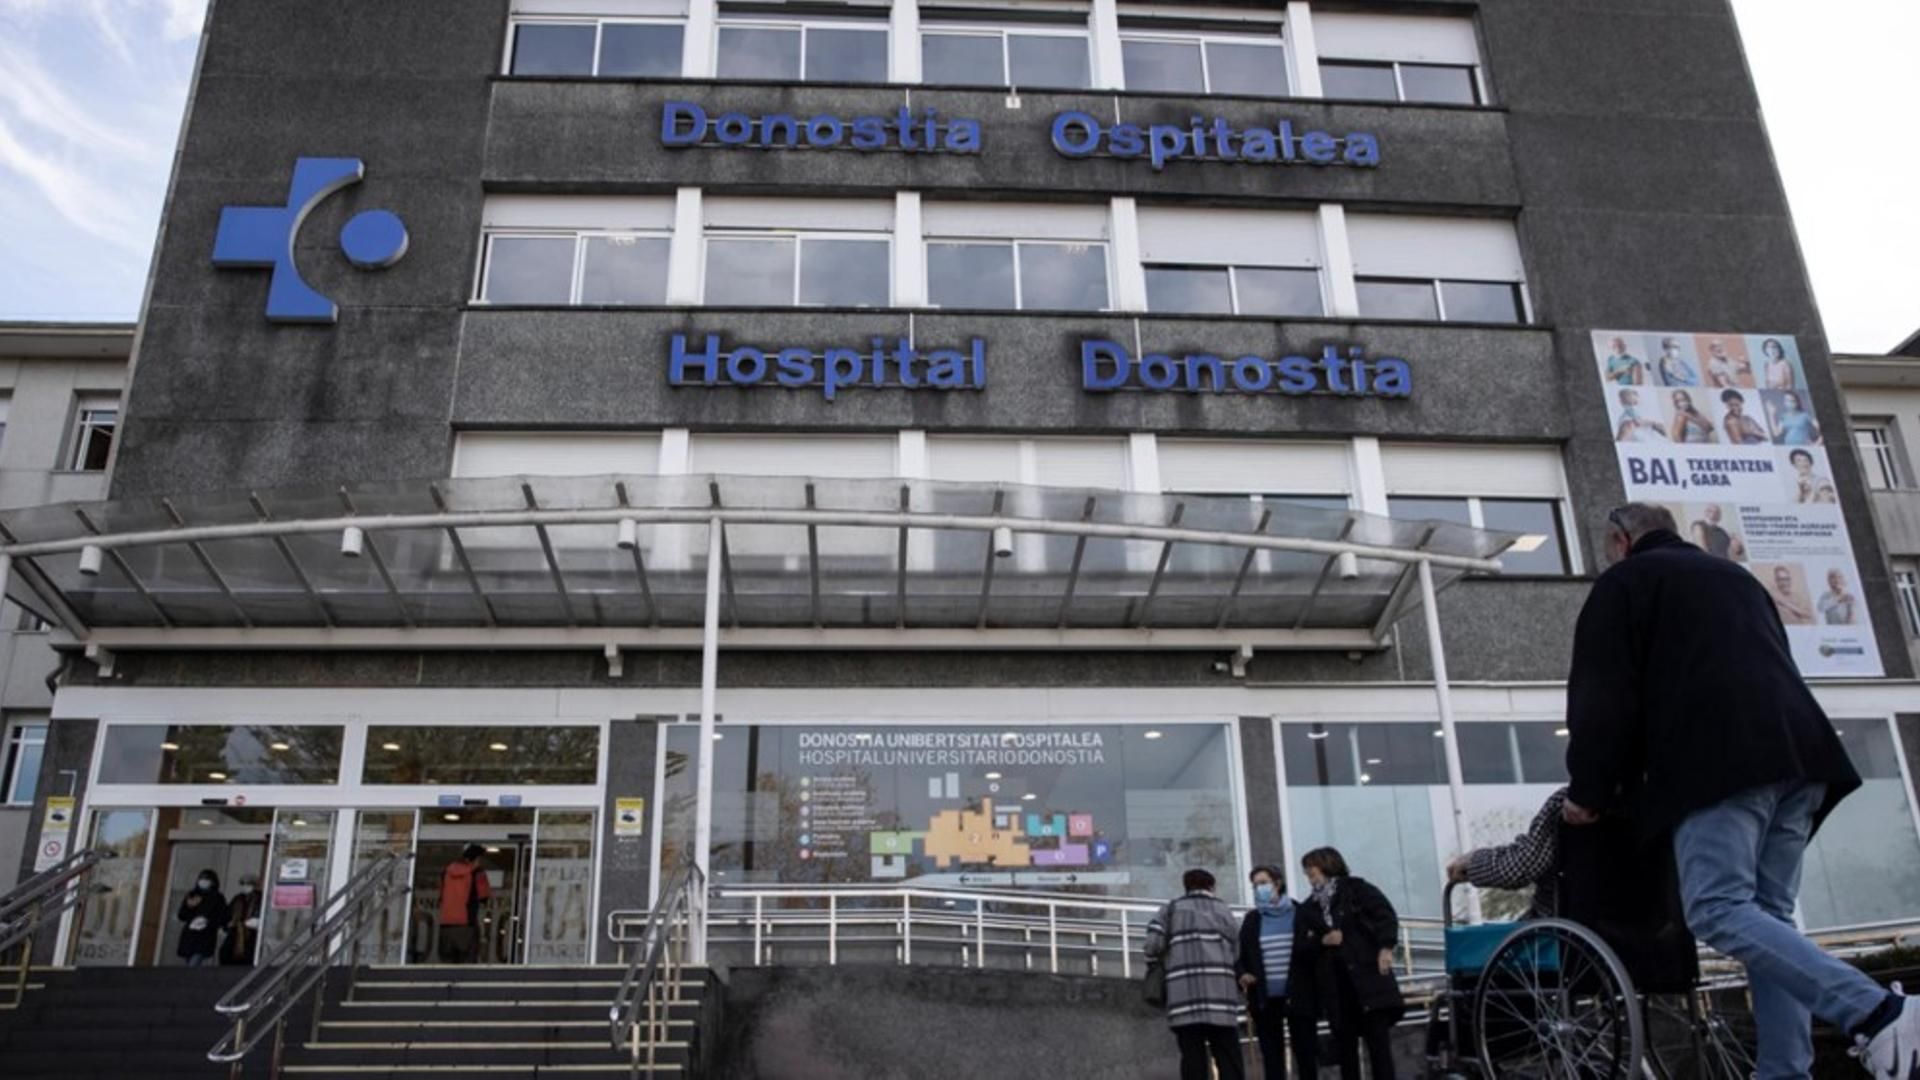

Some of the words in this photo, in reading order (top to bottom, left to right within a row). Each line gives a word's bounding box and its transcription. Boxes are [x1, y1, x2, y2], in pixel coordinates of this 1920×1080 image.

[661, 100, 982, 153] Donostia
[1051, 110, 1381, 169] Ospitalea
[667, 334, 986, 400] Hospital
[1082, 339, 1413, 398] Donostia
[1627, 457, 1687, 489] BAI,
[1686, 458, 1773, 473] TXERTATZEN
[1690, 473, 1731, 487] GARA
